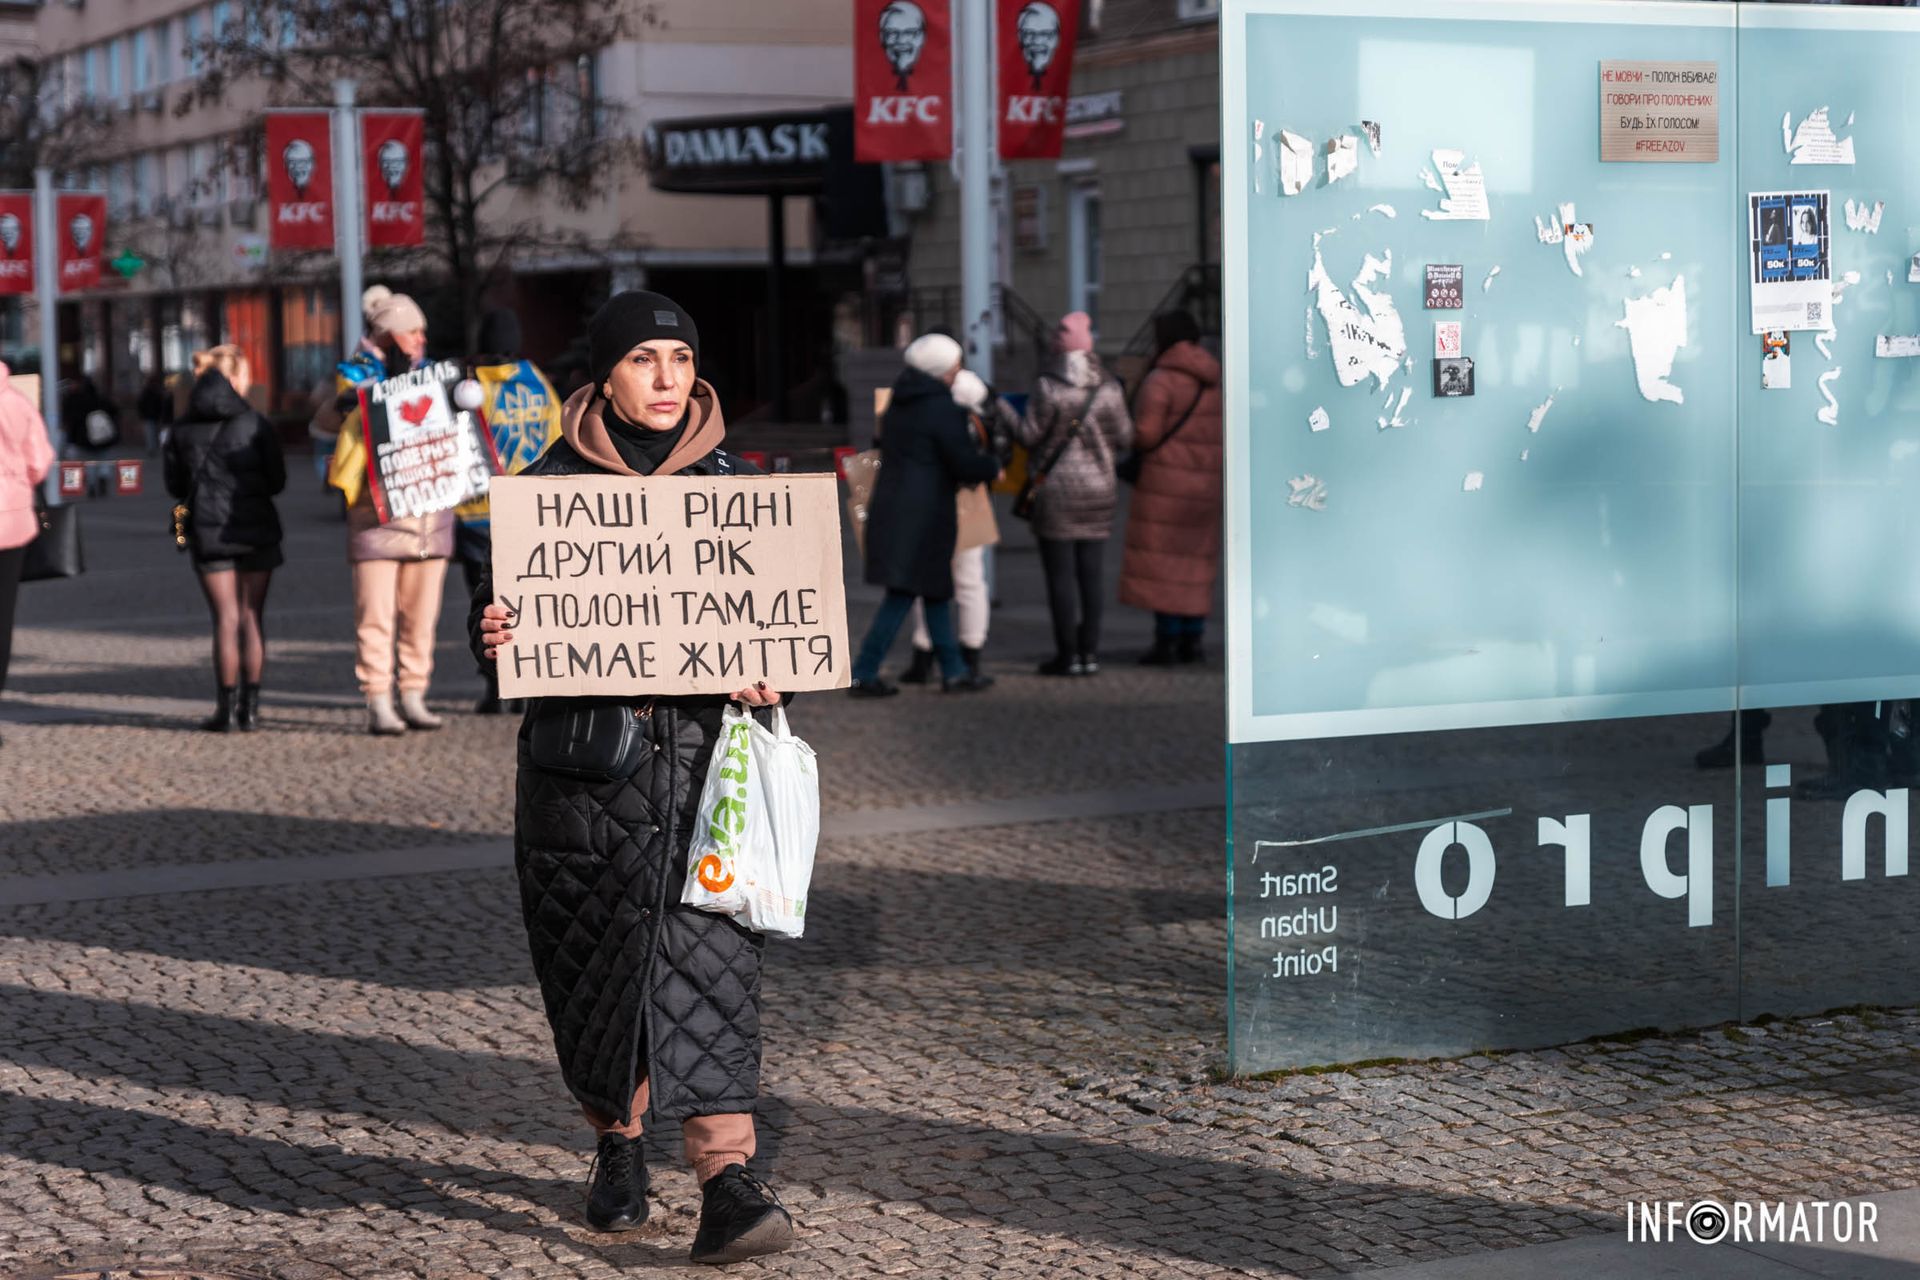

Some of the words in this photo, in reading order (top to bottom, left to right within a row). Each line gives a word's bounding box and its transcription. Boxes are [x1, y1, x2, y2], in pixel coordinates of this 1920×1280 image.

[1602, 70, 1613, 82] НЕ
[1615, 71, 1642, 83] МОВЧИ
[1652, 71, 1679, 83] ПОЛОН
[1681, 72, 1717, 83] ВБИВАЄ!
[867, 95, 940, 123] KFC
[1006, 96, 1061, 123] KFC
[1606, 93, 1641, 105] ГОВОРИ
[1642, 94, 1660, 105] ПРО
[1661, 94, 1712, 106] ПОЛОНЕНИХ!
[1620, 116, 1643, 129] БУДЬ
[1658, 117, 1700, 129] ГОЛОСОМ!
[664, 123, 829, 165] DAMASK
[1635, 140, 1685, 152] #FREEAZOV
[278, 202, 325, 223] KFC
[372, 201, 416, 222] KFC
[536, 487, 648, 528] НАШІ
[684, 485, 793, 532] РІДНІ
[516, 532, 672, 582] ДРУГИЙ
[695, 536, 755, 576] РІК
[500, 594, 523, 629] У
[535, 585, 661, 629] ПОЛОНІ
[678, 634, 833, 679] ЖИТТЯ
